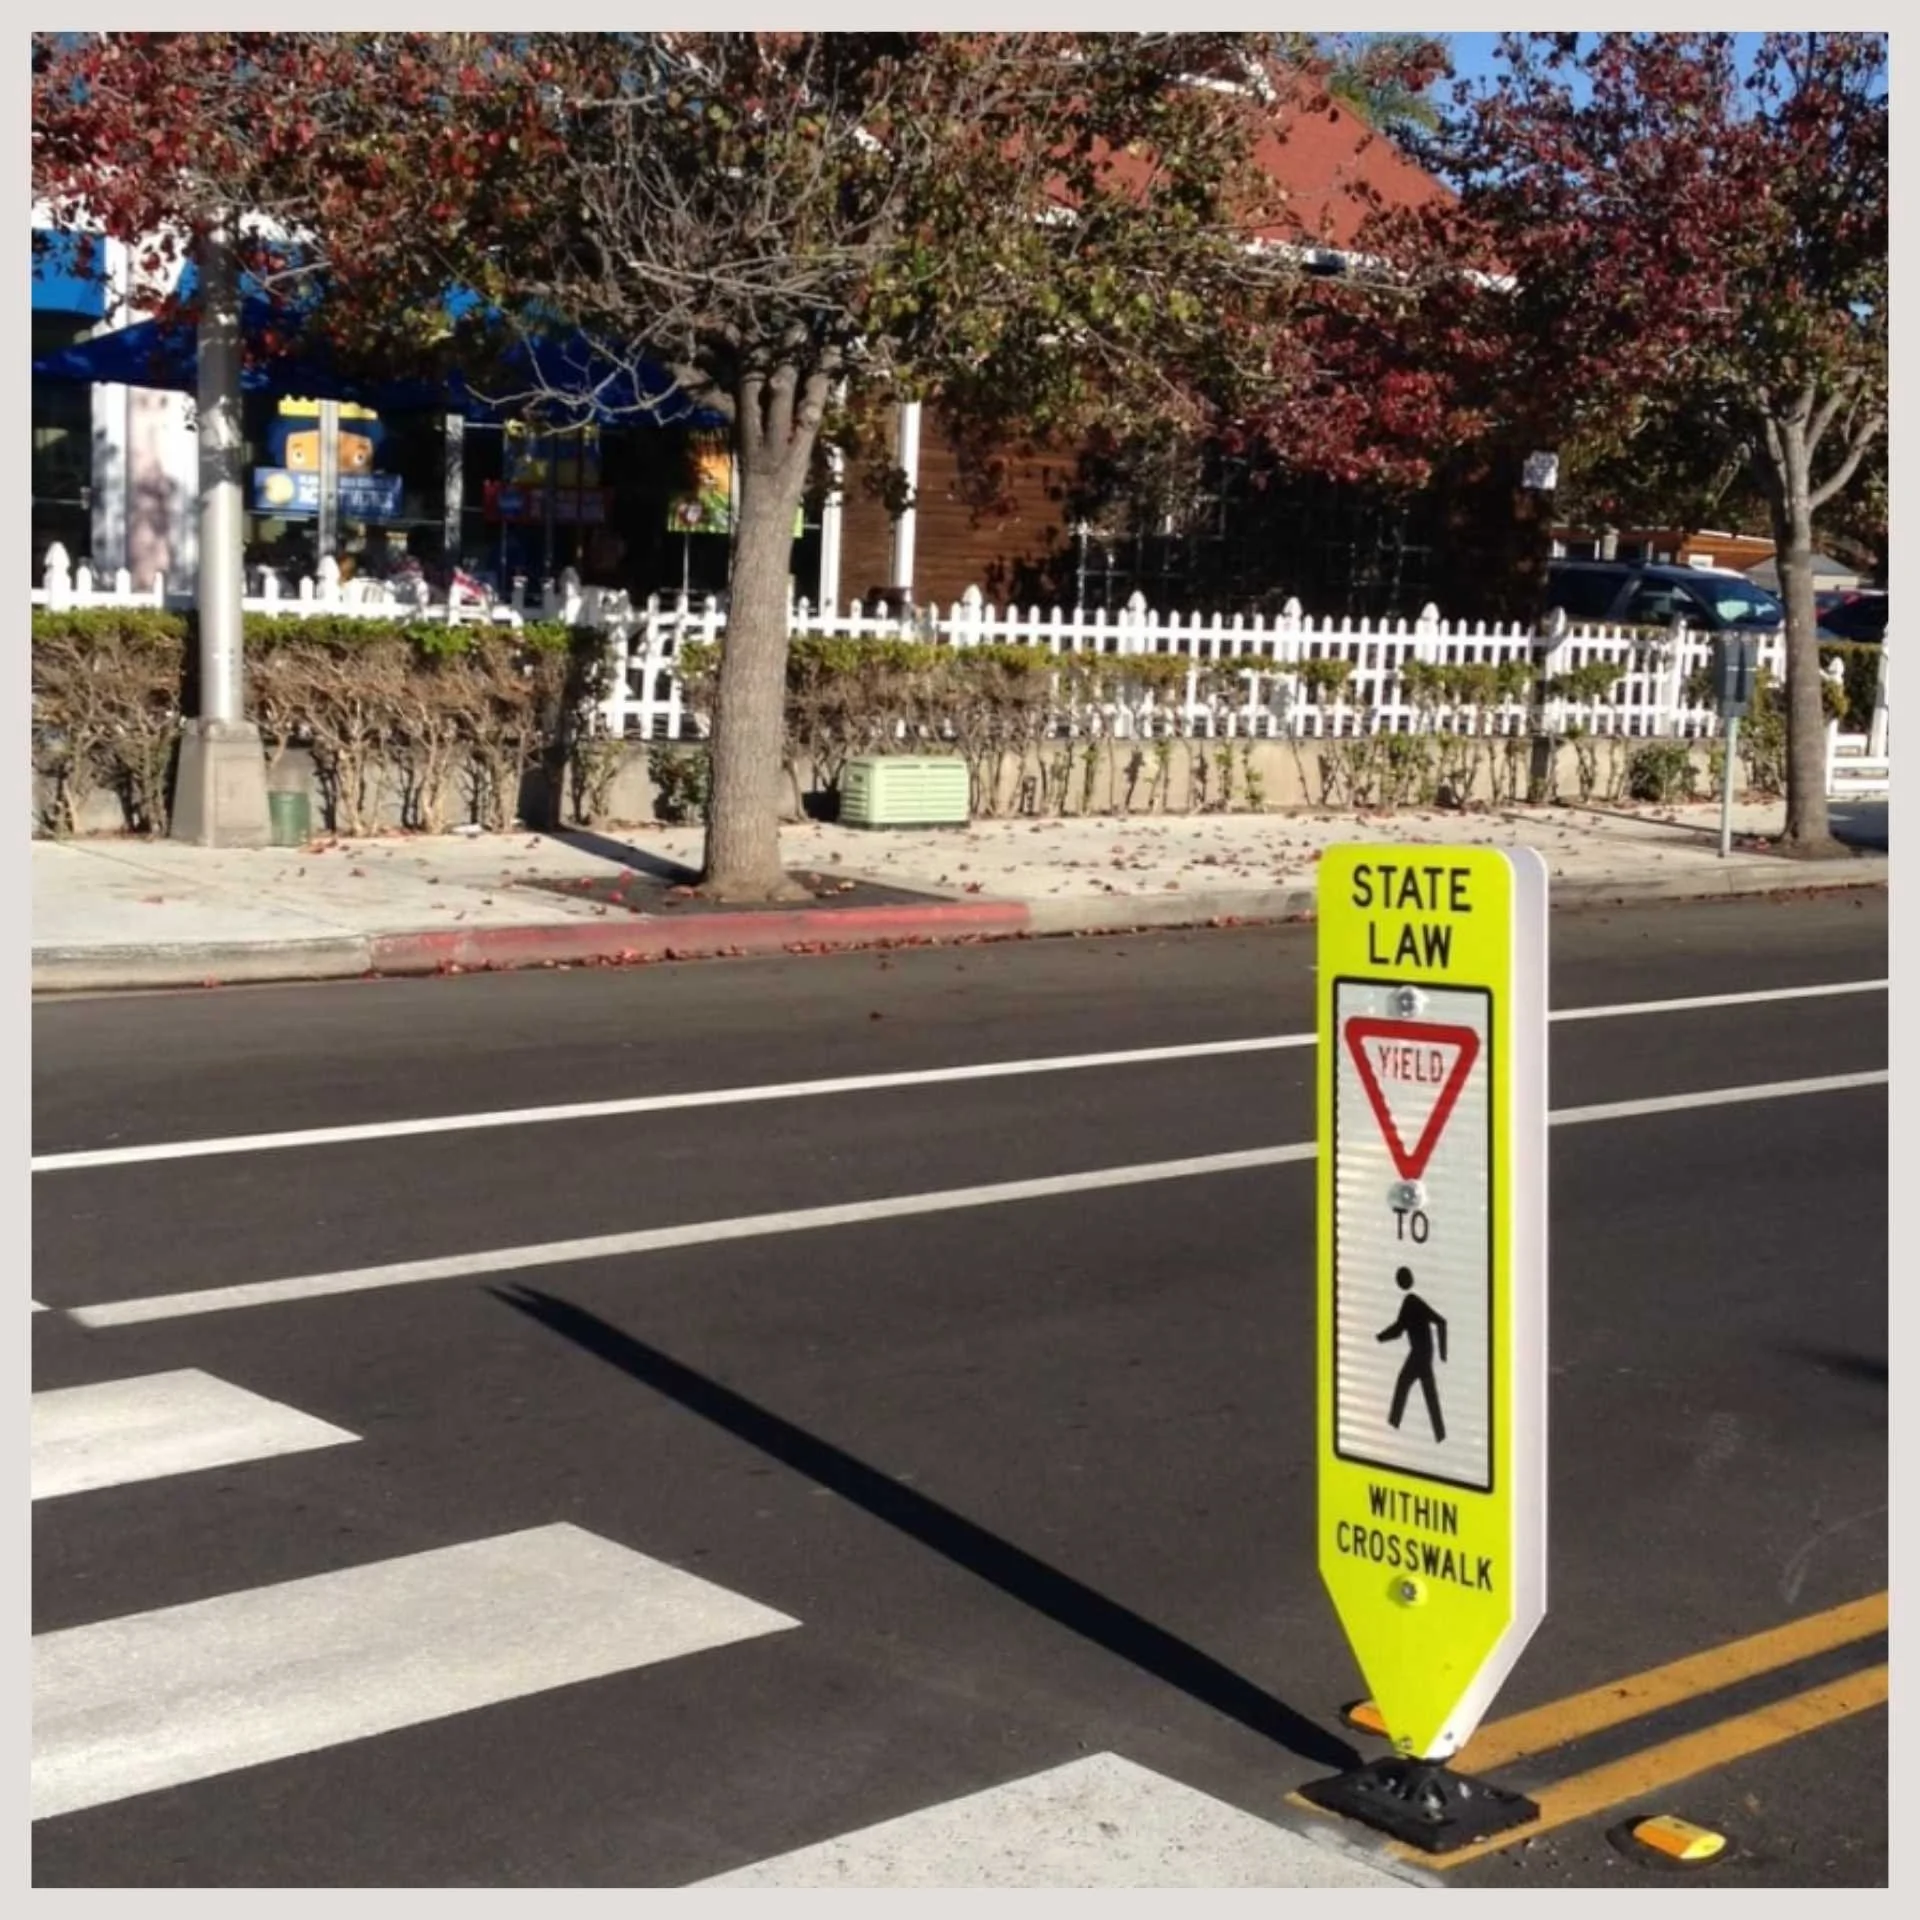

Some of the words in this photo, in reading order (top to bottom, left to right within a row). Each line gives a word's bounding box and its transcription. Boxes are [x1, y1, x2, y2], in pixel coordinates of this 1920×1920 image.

[1352, 865, 1472, 912] STATE
[1369, 922, 1452, 968] LAW
[1378, 1046, 1444, 1082] YIELD
[1392, 1208, 1429, 1243] TO
[1369, 1486, 1457, 1535] WITHIN
[1337, 1522, 1492, 1590] CROSSWALK
